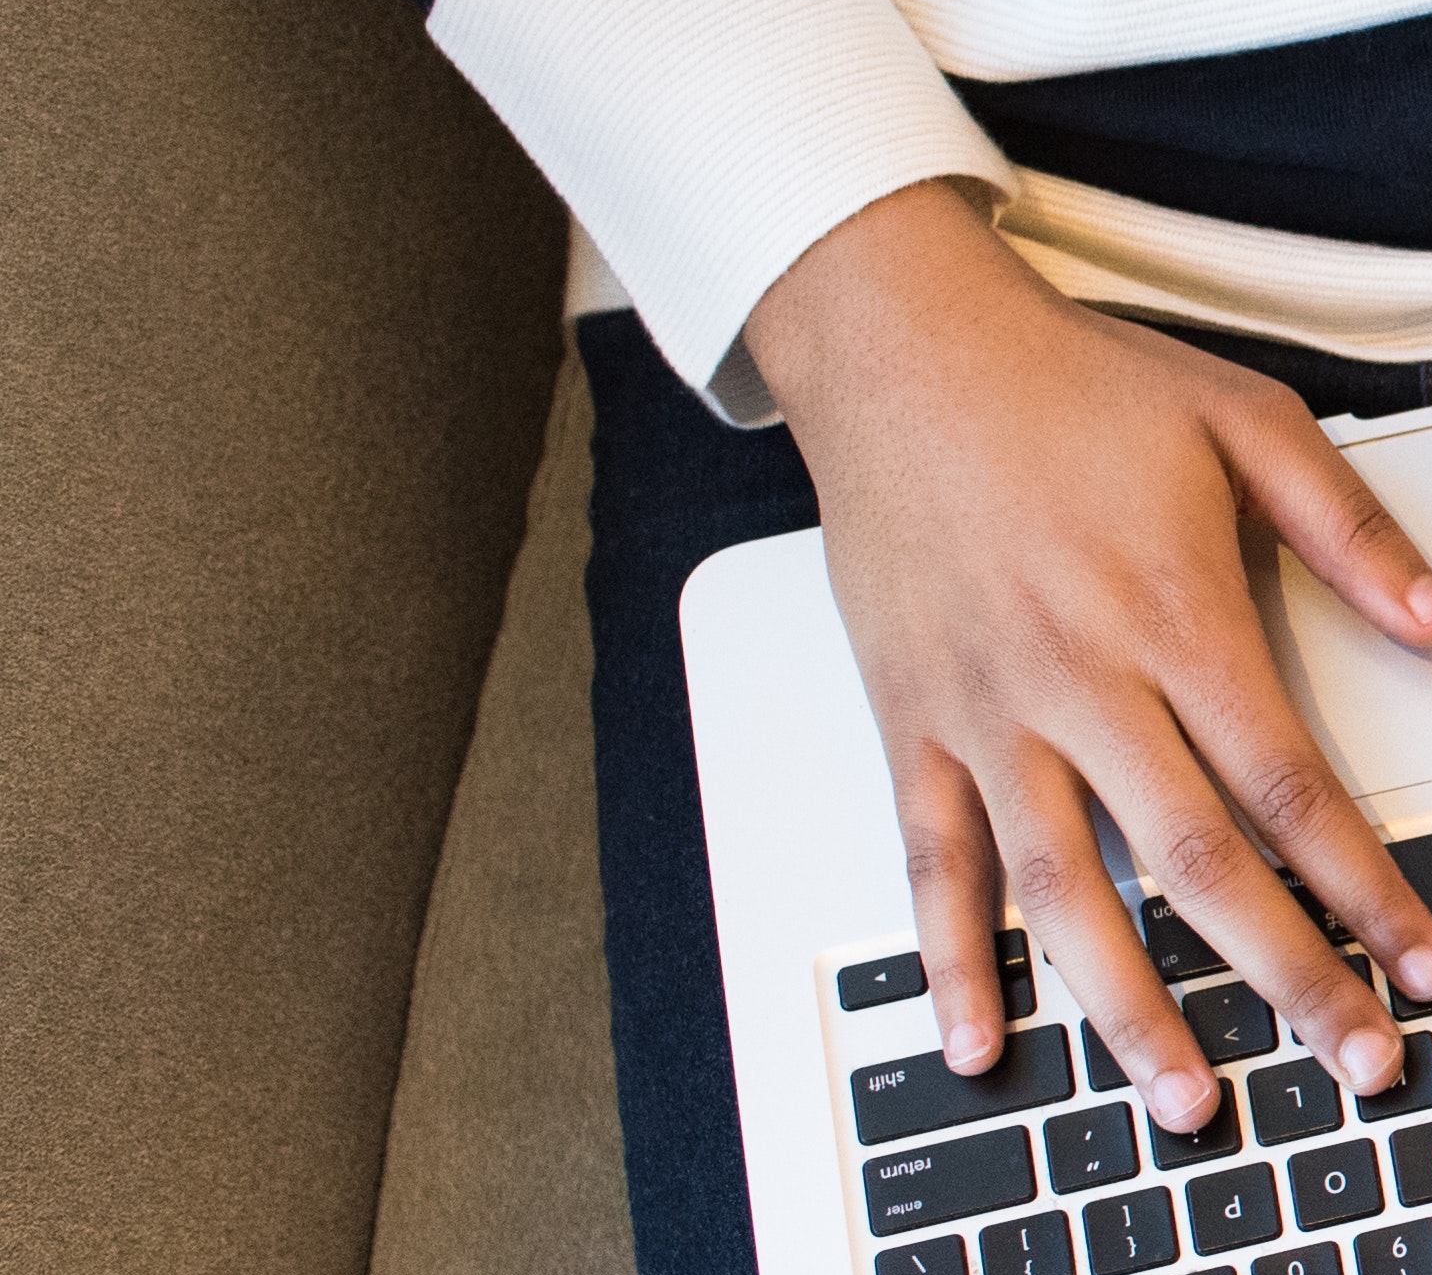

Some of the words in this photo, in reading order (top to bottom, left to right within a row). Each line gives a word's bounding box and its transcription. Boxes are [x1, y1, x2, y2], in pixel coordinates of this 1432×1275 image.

[868, 1070, 906, 1092] shift
[1286, 1086, 1302, 1107] L
[879, 1157, 932, 1180] return
[887, 1200, 922, 1216] enter
[1225, 1195, 1241, 1218] P
